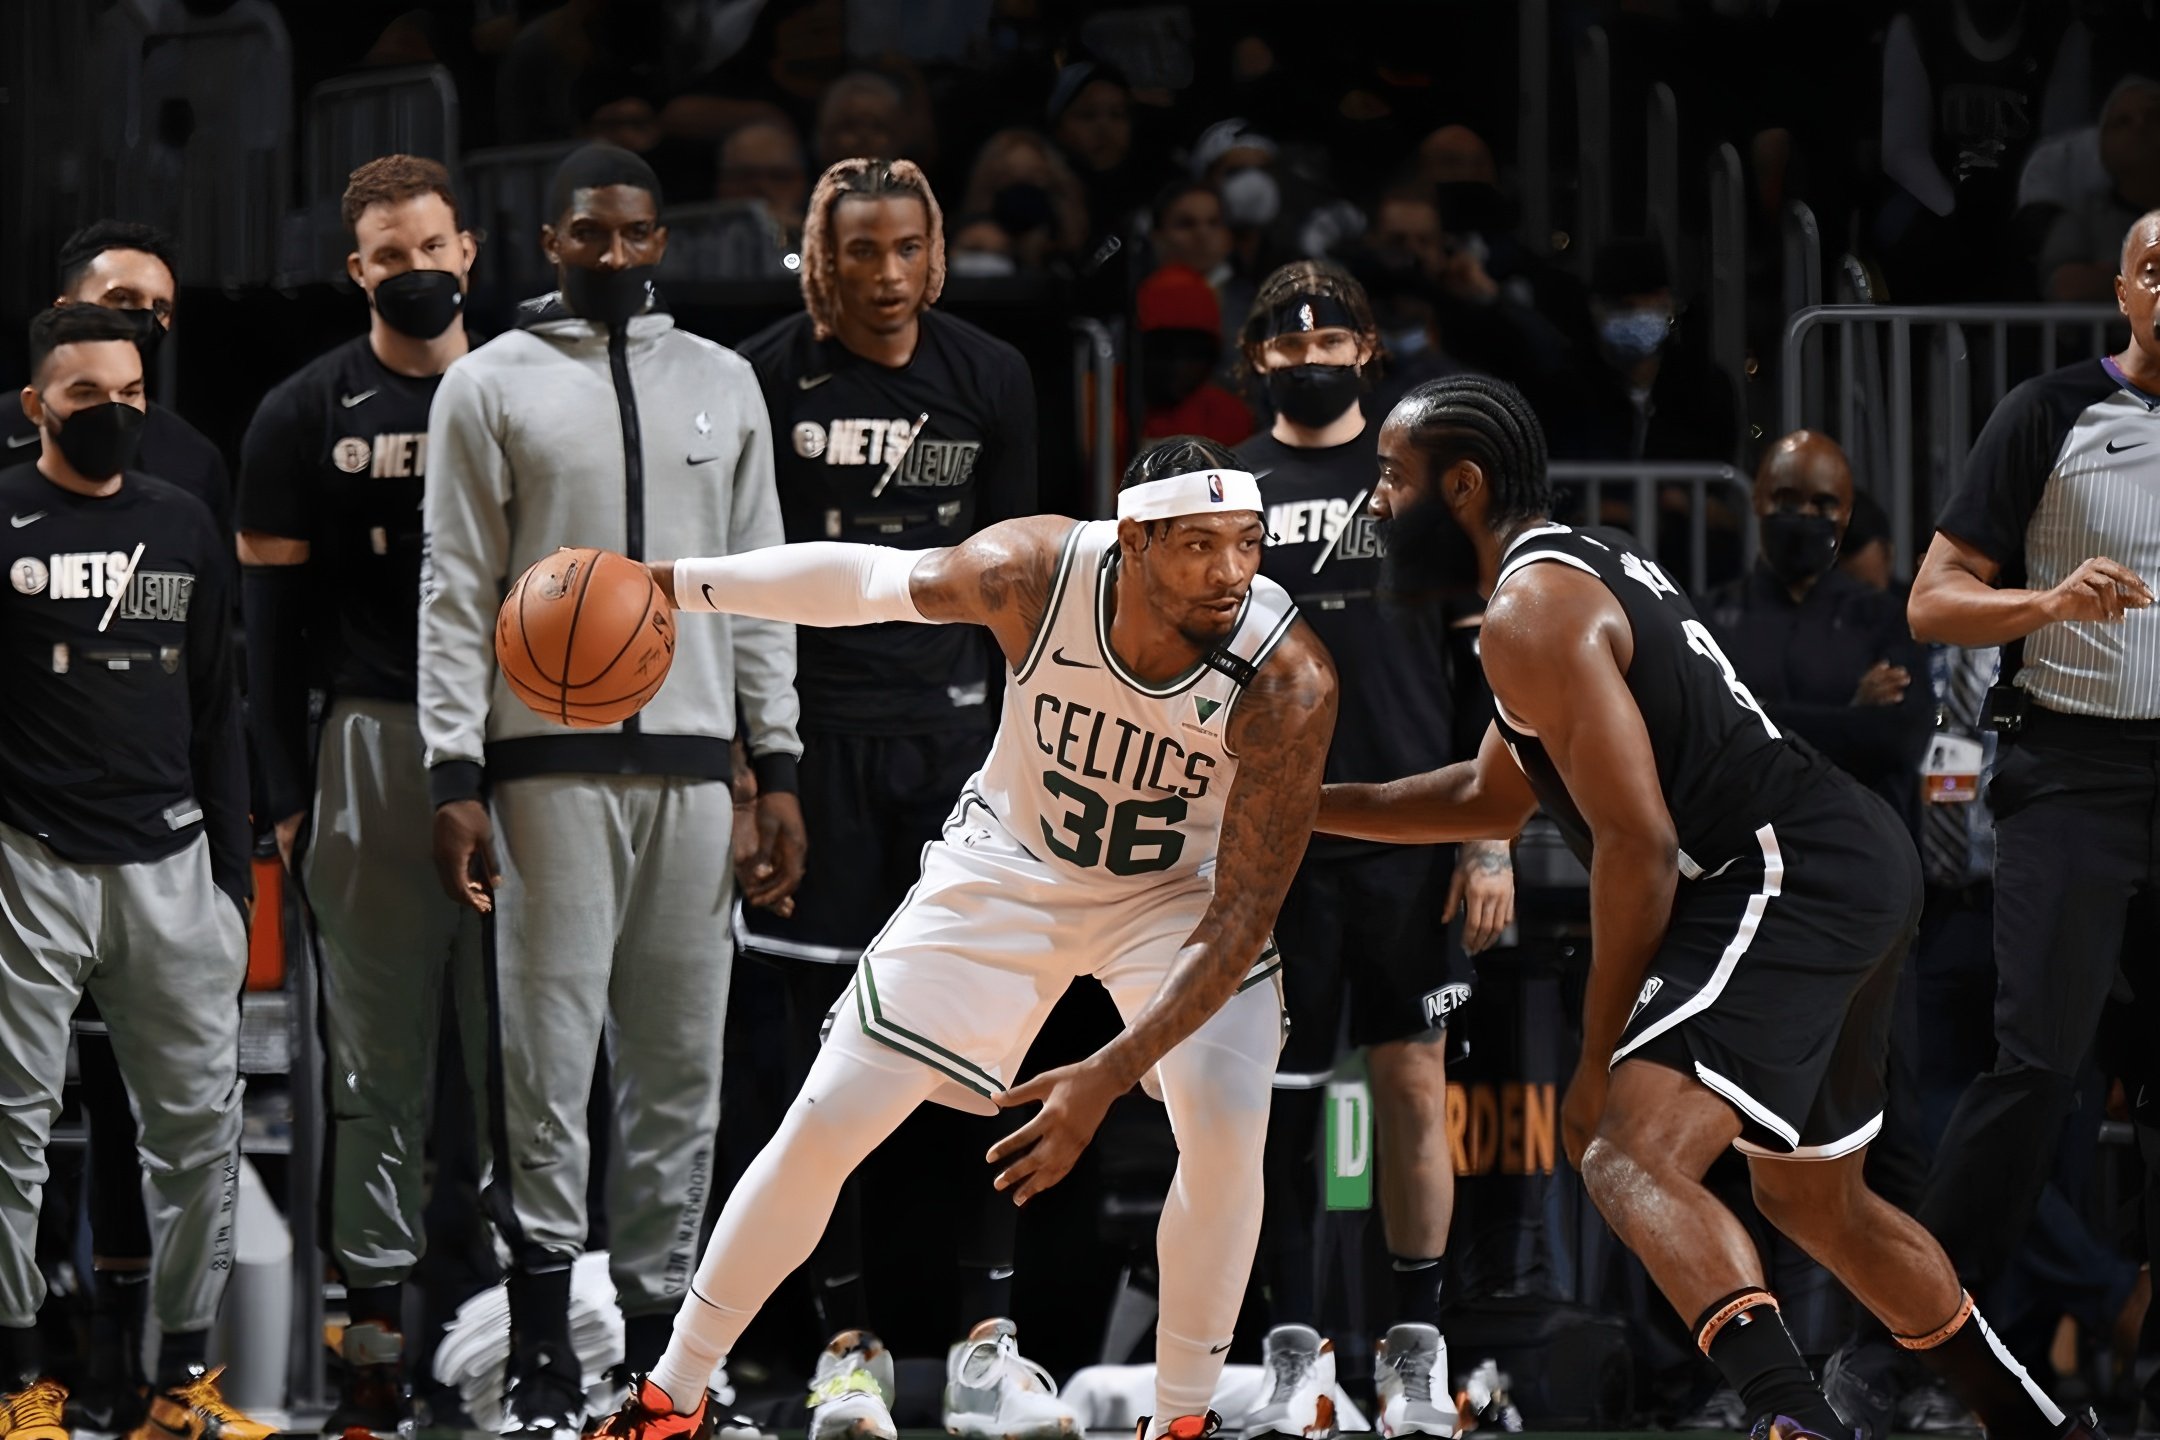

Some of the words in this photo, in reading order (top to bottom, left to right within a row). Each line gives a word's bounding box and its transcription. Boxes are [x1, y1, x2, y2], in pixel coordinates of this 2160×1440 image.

[826, 418, 912, 467] NETS
[1264, 497, 1350, 548] NETS
[50, 551, 130, 599] NETS
[1034, 693, 1217, 799] CELTICS
[1040, 770, 1188, 876] 36
[1427, 987, 1471, 1020] NETS
